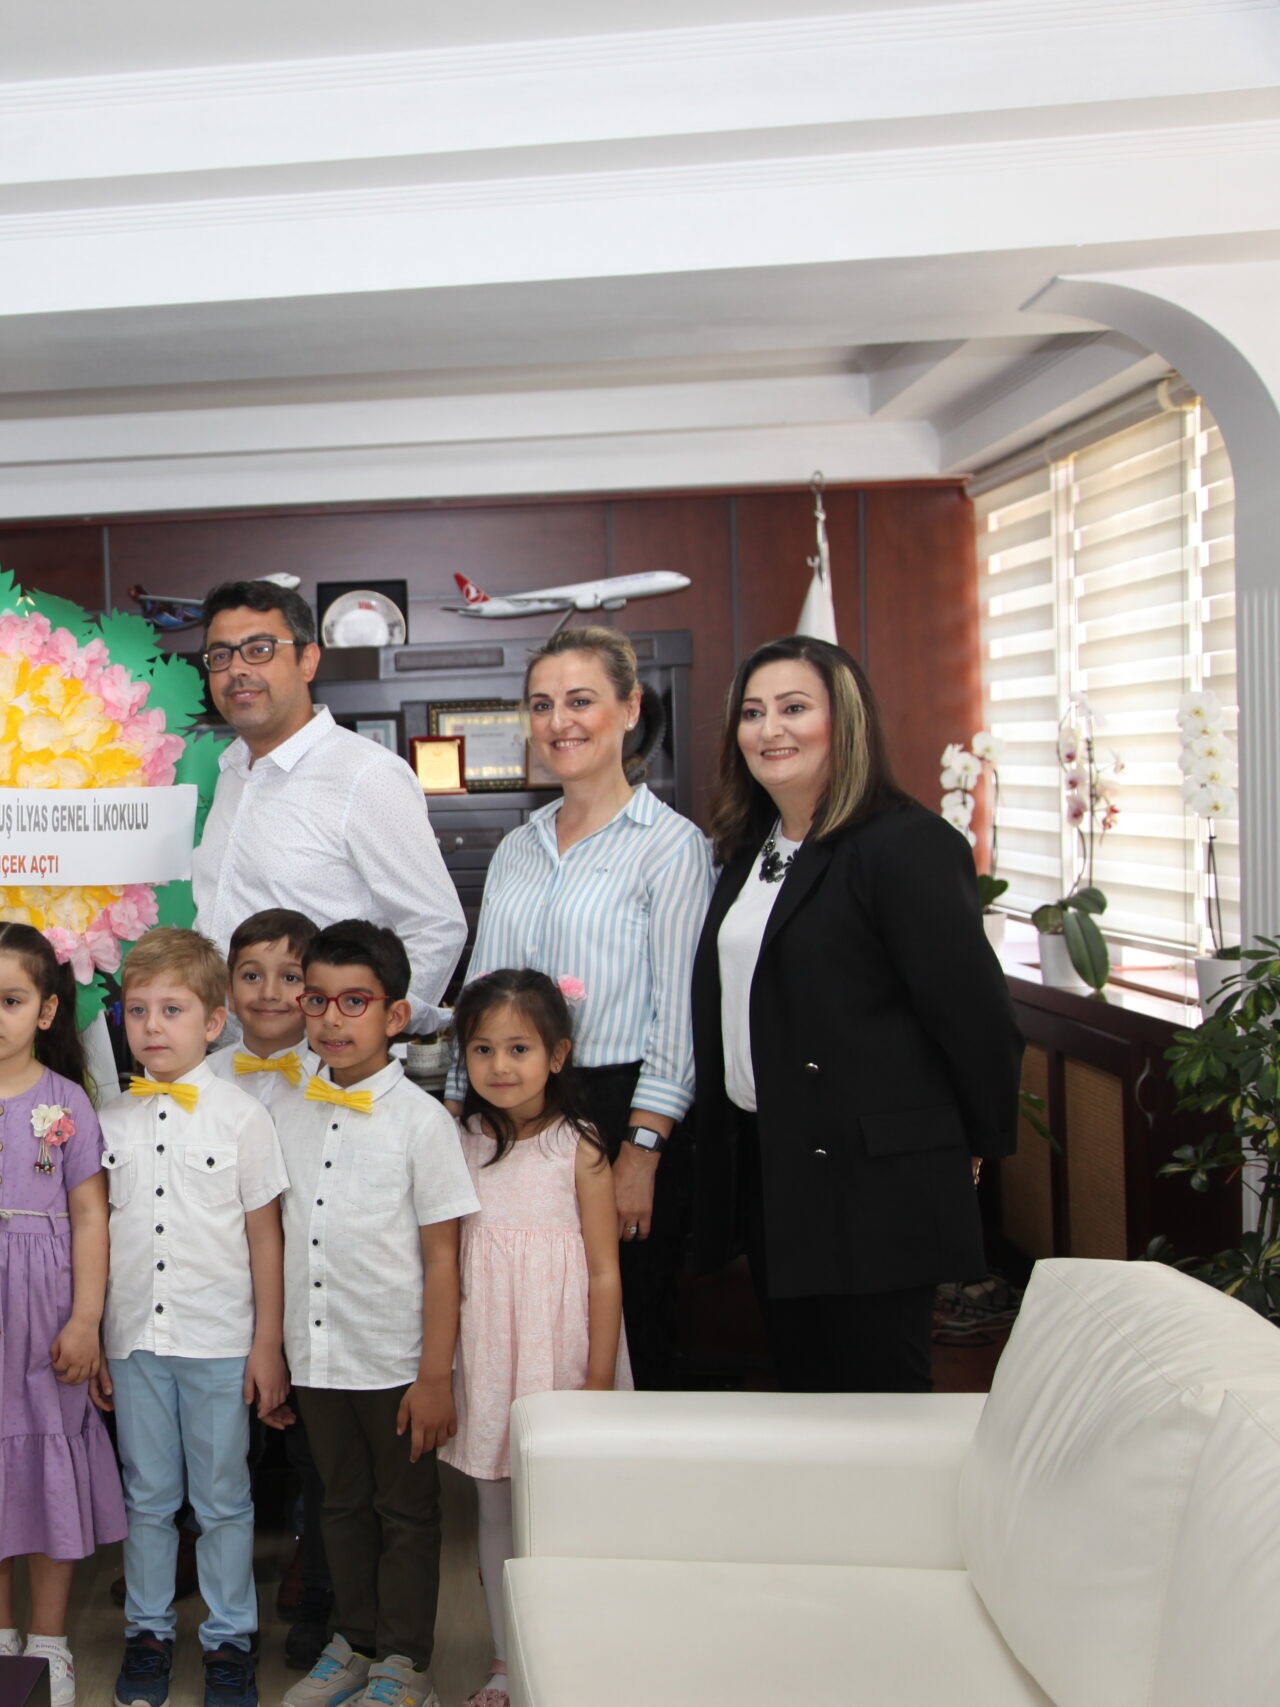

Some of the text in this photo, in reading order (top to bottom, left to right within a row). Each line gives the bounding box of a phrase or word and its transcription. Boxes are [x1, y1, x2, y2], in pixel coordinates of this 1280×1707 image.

[16, 797, 48, 832] İLYAS
[51, 804, 90, 832] GENEL
[93, 797, 149, 831] İLKOKULU
[30, 855, 59, 877] AÇTI
